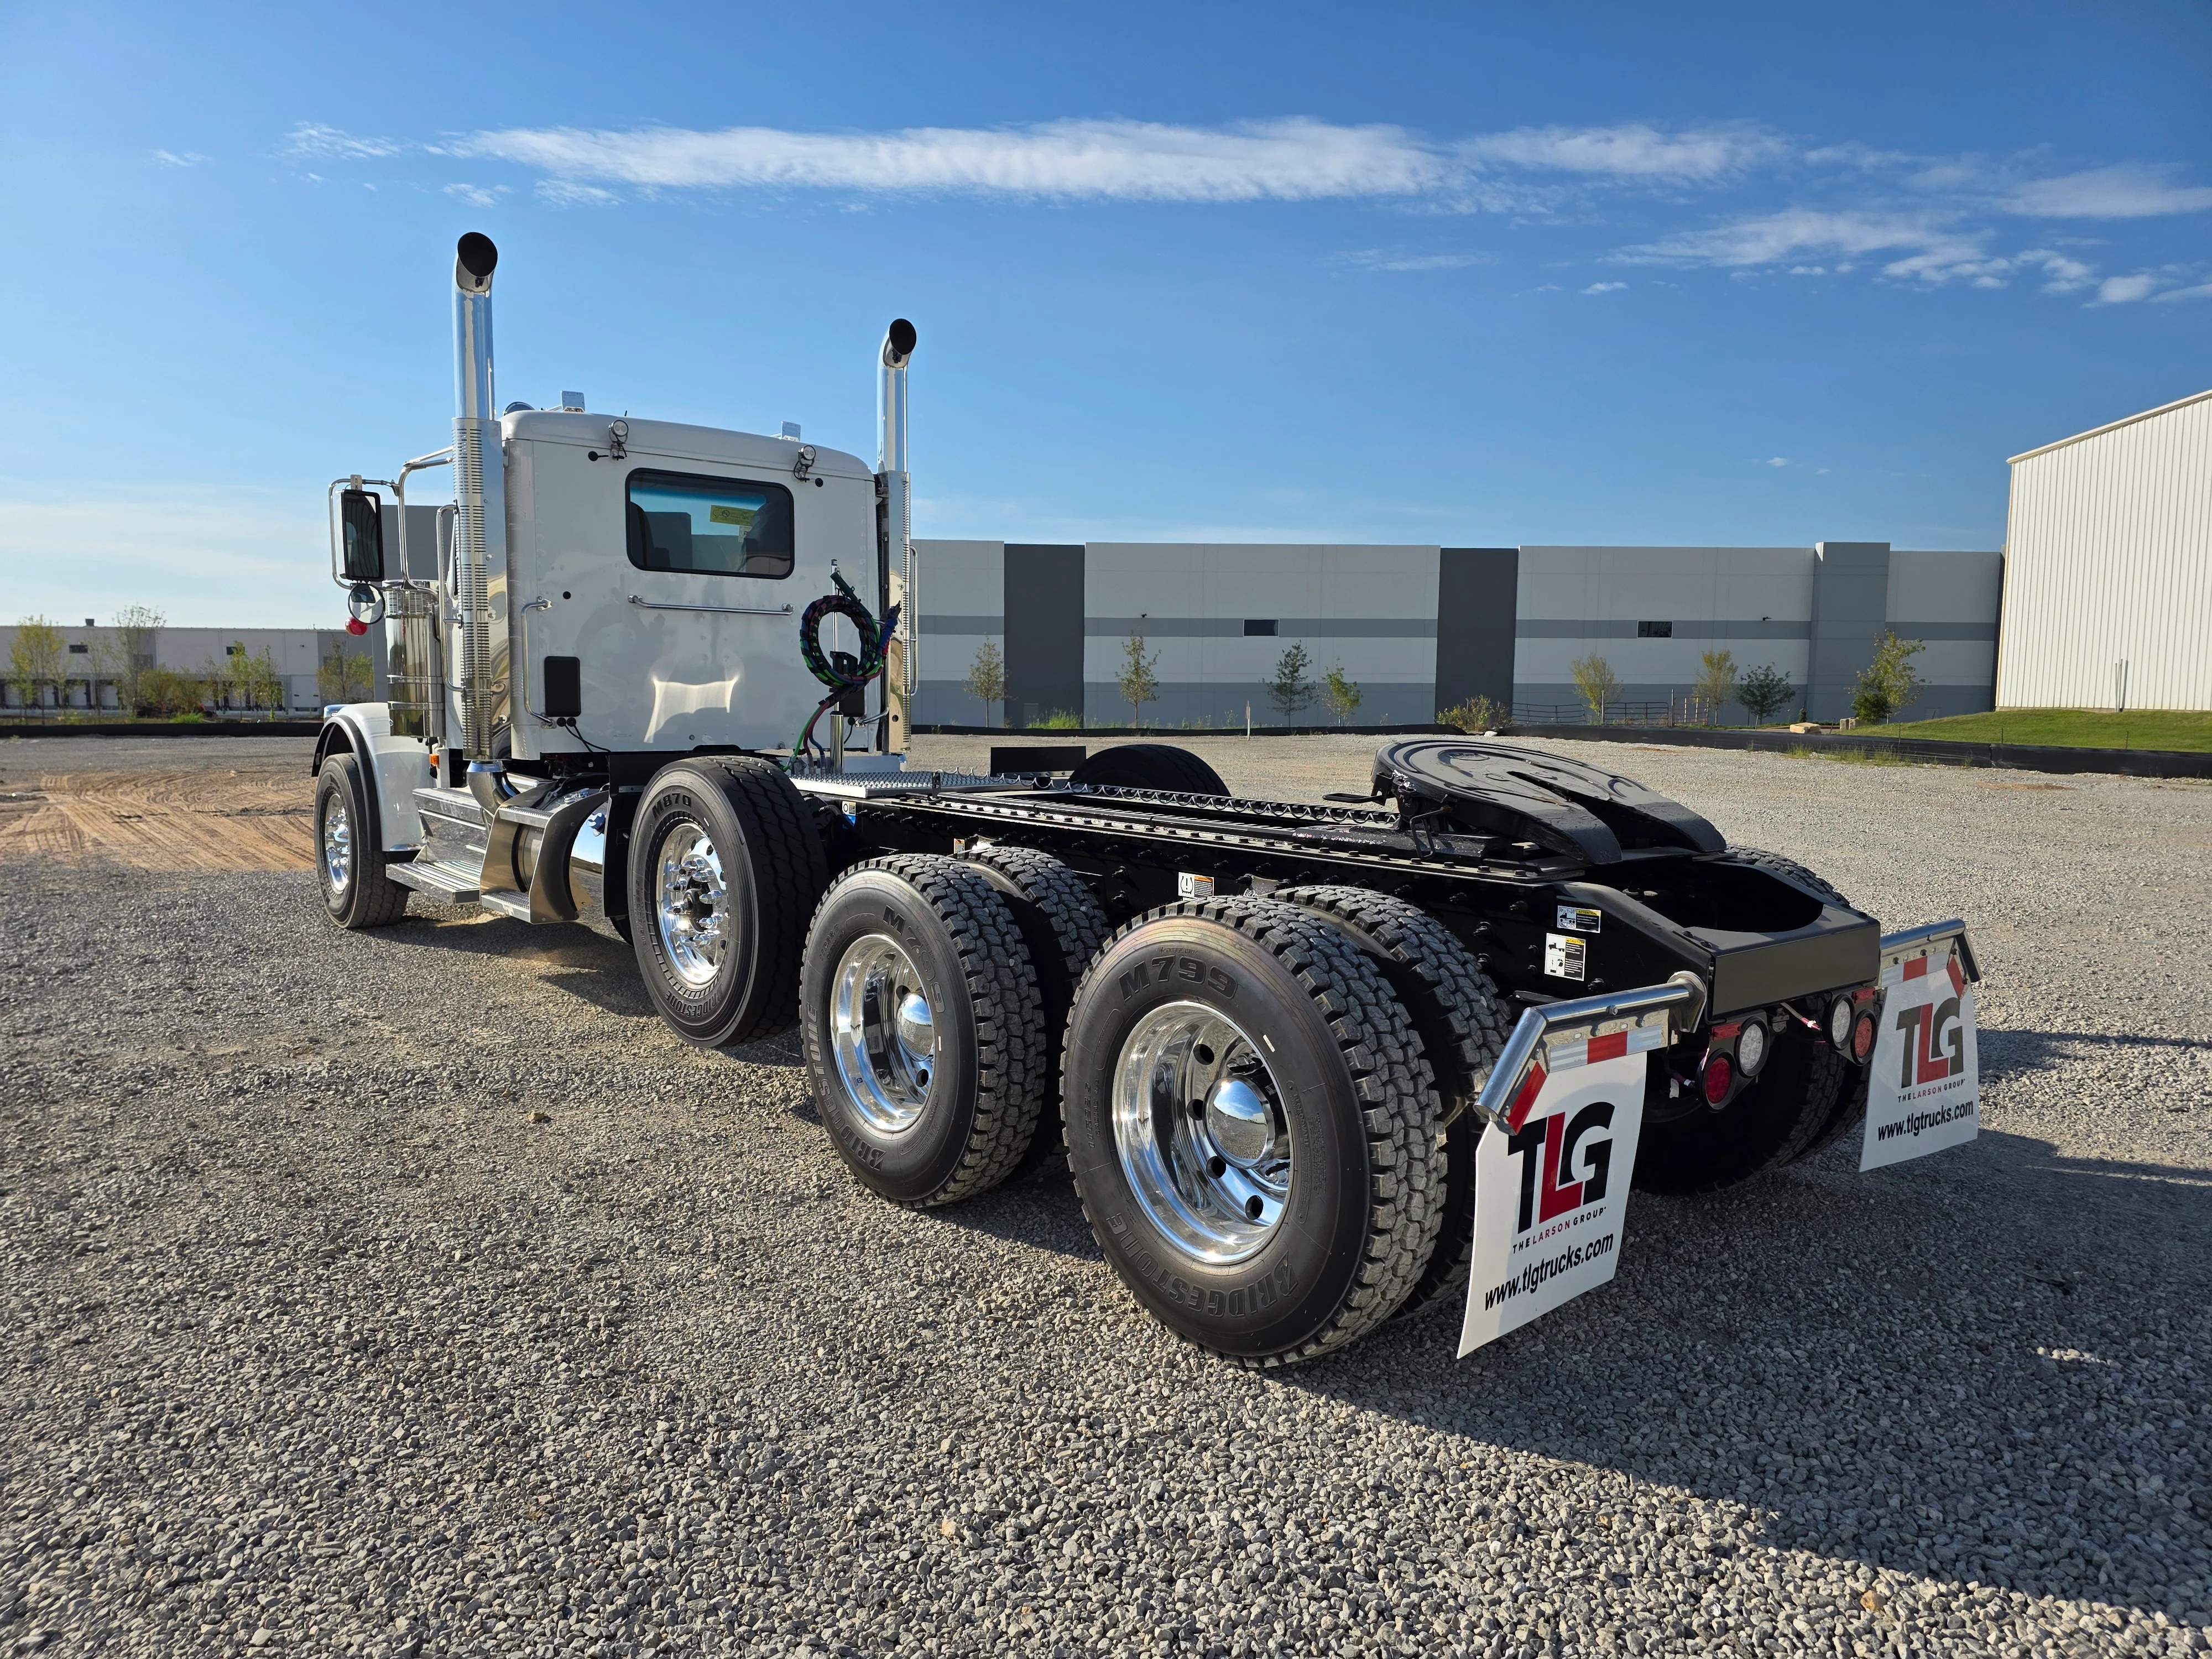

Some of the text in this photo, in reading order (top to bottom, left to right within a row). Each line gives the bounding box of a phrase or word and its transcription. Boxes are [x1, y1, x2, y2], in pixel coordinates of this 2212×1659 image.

[652, 792, 692, 821] M870
[883, 904, 945, 1013] M799
[1118, 954, 1238, 1003] M799
[664, 984, 724, 1018] BRIDGESTONE
[1896, 997, 1964, 1089] TLG
[807, 1001, 886, 1171] BRIDGESTONE
[1898, 1079, 1964, 1103] THE LARSON GROUP
[1878, 1100, 1974, 1141] www.tlgtrucks.com
[1507, 1101, 1615, 1234] TLG
[1513, 1207, 1604, 1254] THE LARSON GROUP
[1105, 1212, 1298, 1317] BRIDGESTONE
[1485, 1233, 1614, 1311] www.tlgtrucks.com
